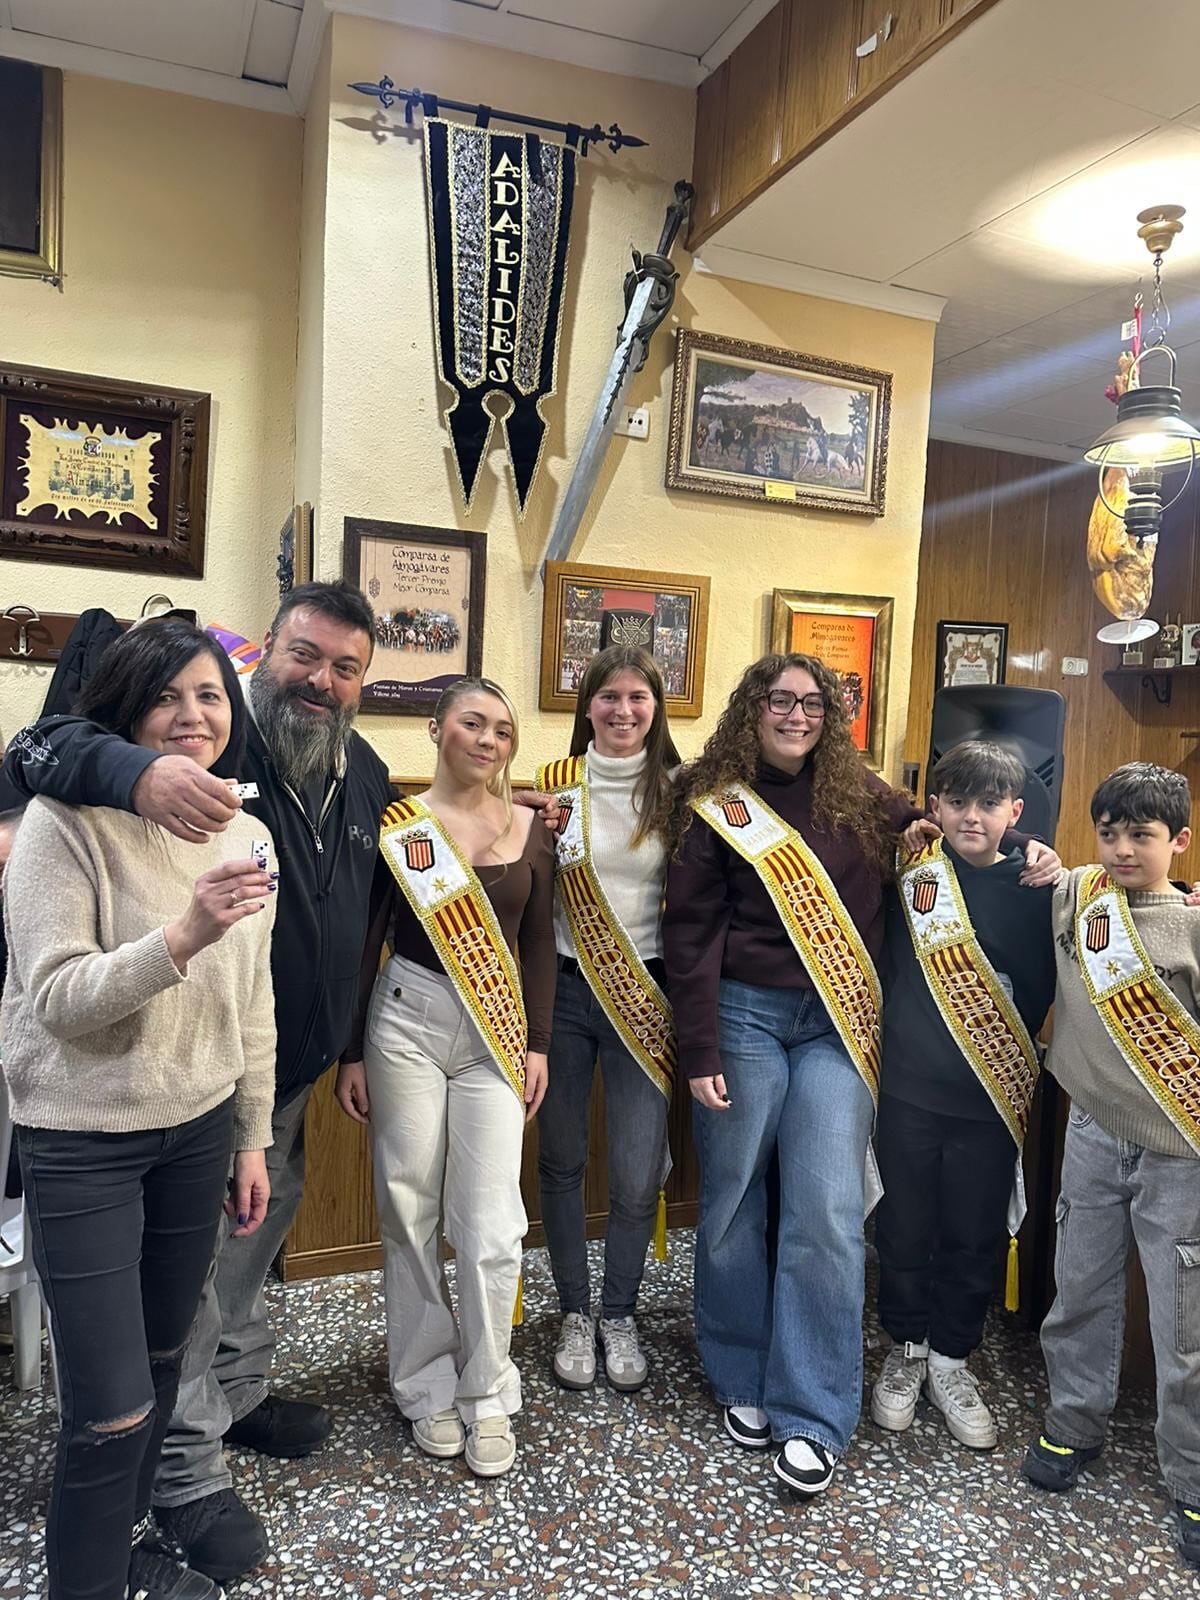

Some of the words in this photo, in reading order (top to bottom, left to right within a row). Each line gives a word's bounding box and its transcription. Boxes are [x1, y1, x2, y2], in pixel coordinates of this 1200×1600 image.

[488, 151, 522, 384] ADALIDES
[392, 546, 437, 561] Comparsa
[440, 552, 451, 563] de
